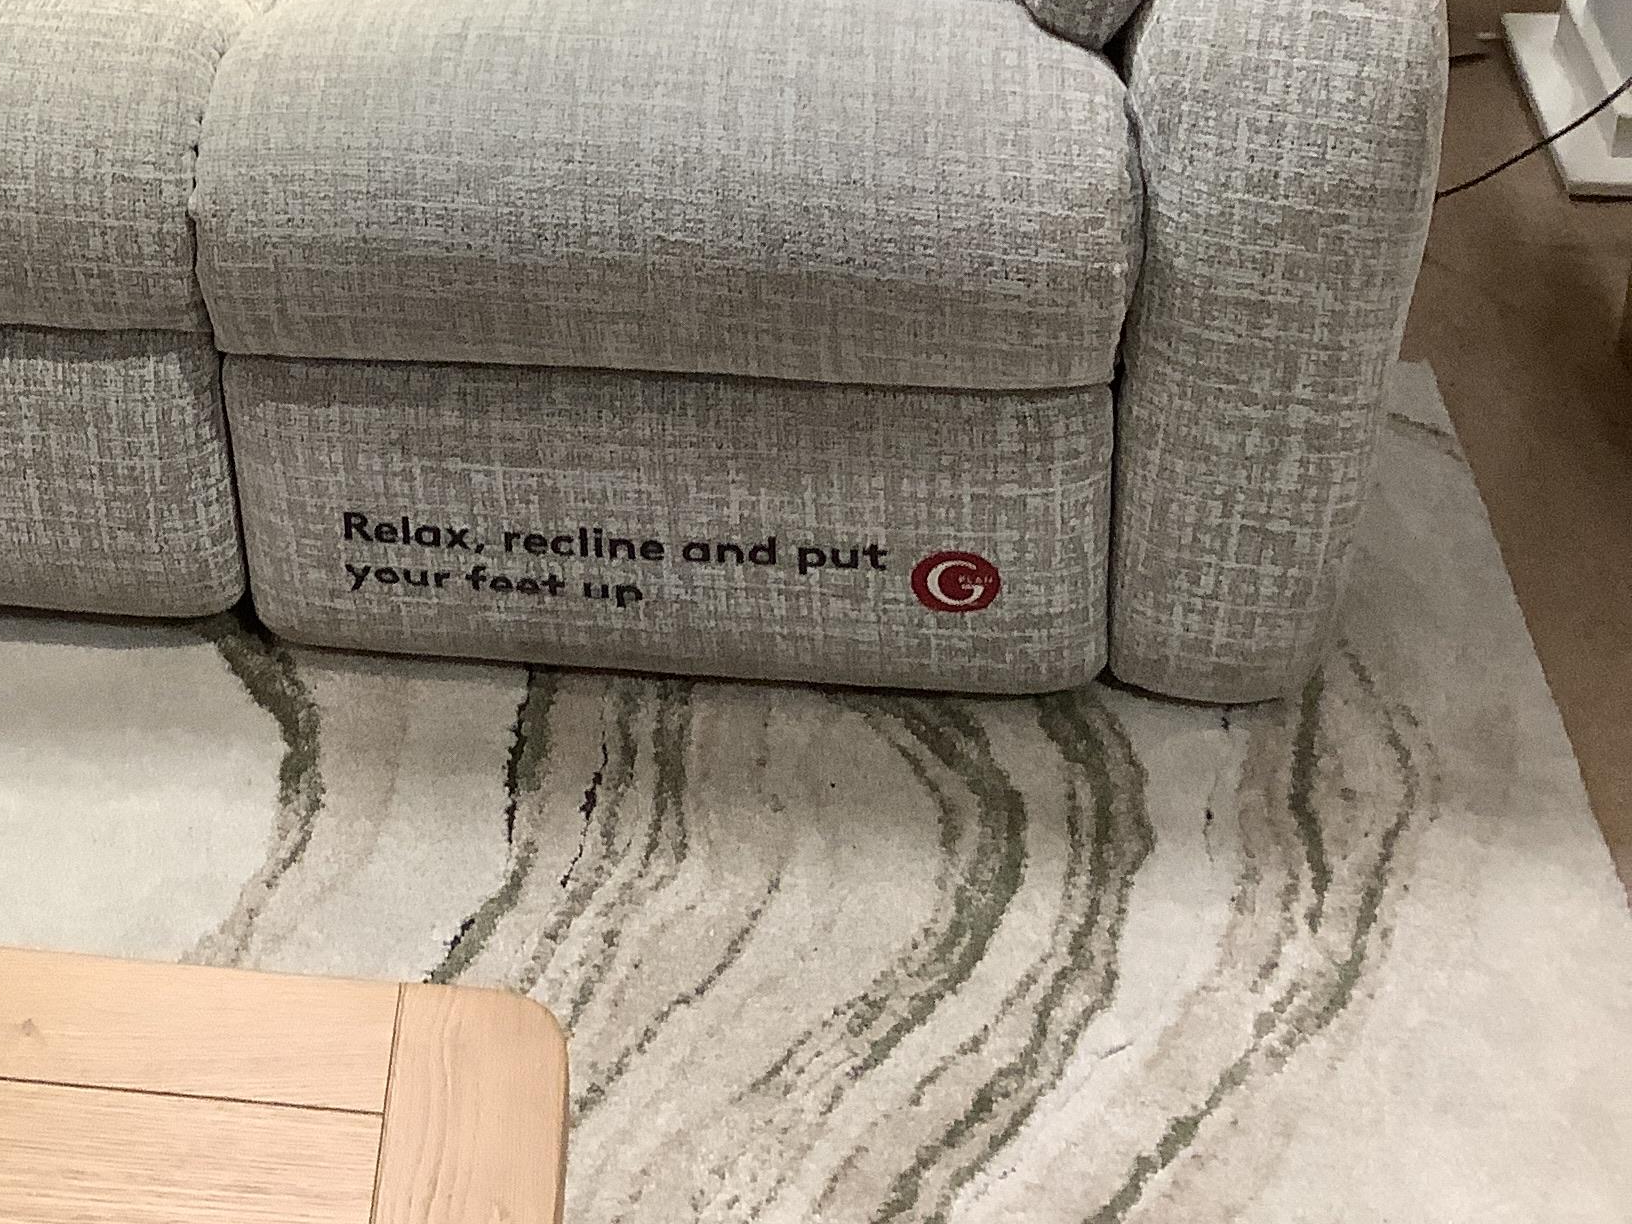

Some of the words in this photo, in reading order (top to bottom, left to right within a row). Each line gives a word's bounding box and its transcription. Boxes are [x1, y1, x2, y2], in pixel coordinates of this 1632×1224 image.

[343, 511, 485, 554] Relax,
[503, 527, 666, 561] recline
[681, 536, 778, 566] and
[797, 542, 890, 576] put
[344, 564, 452, 592] your
[464, 564, 567, 596] feet
